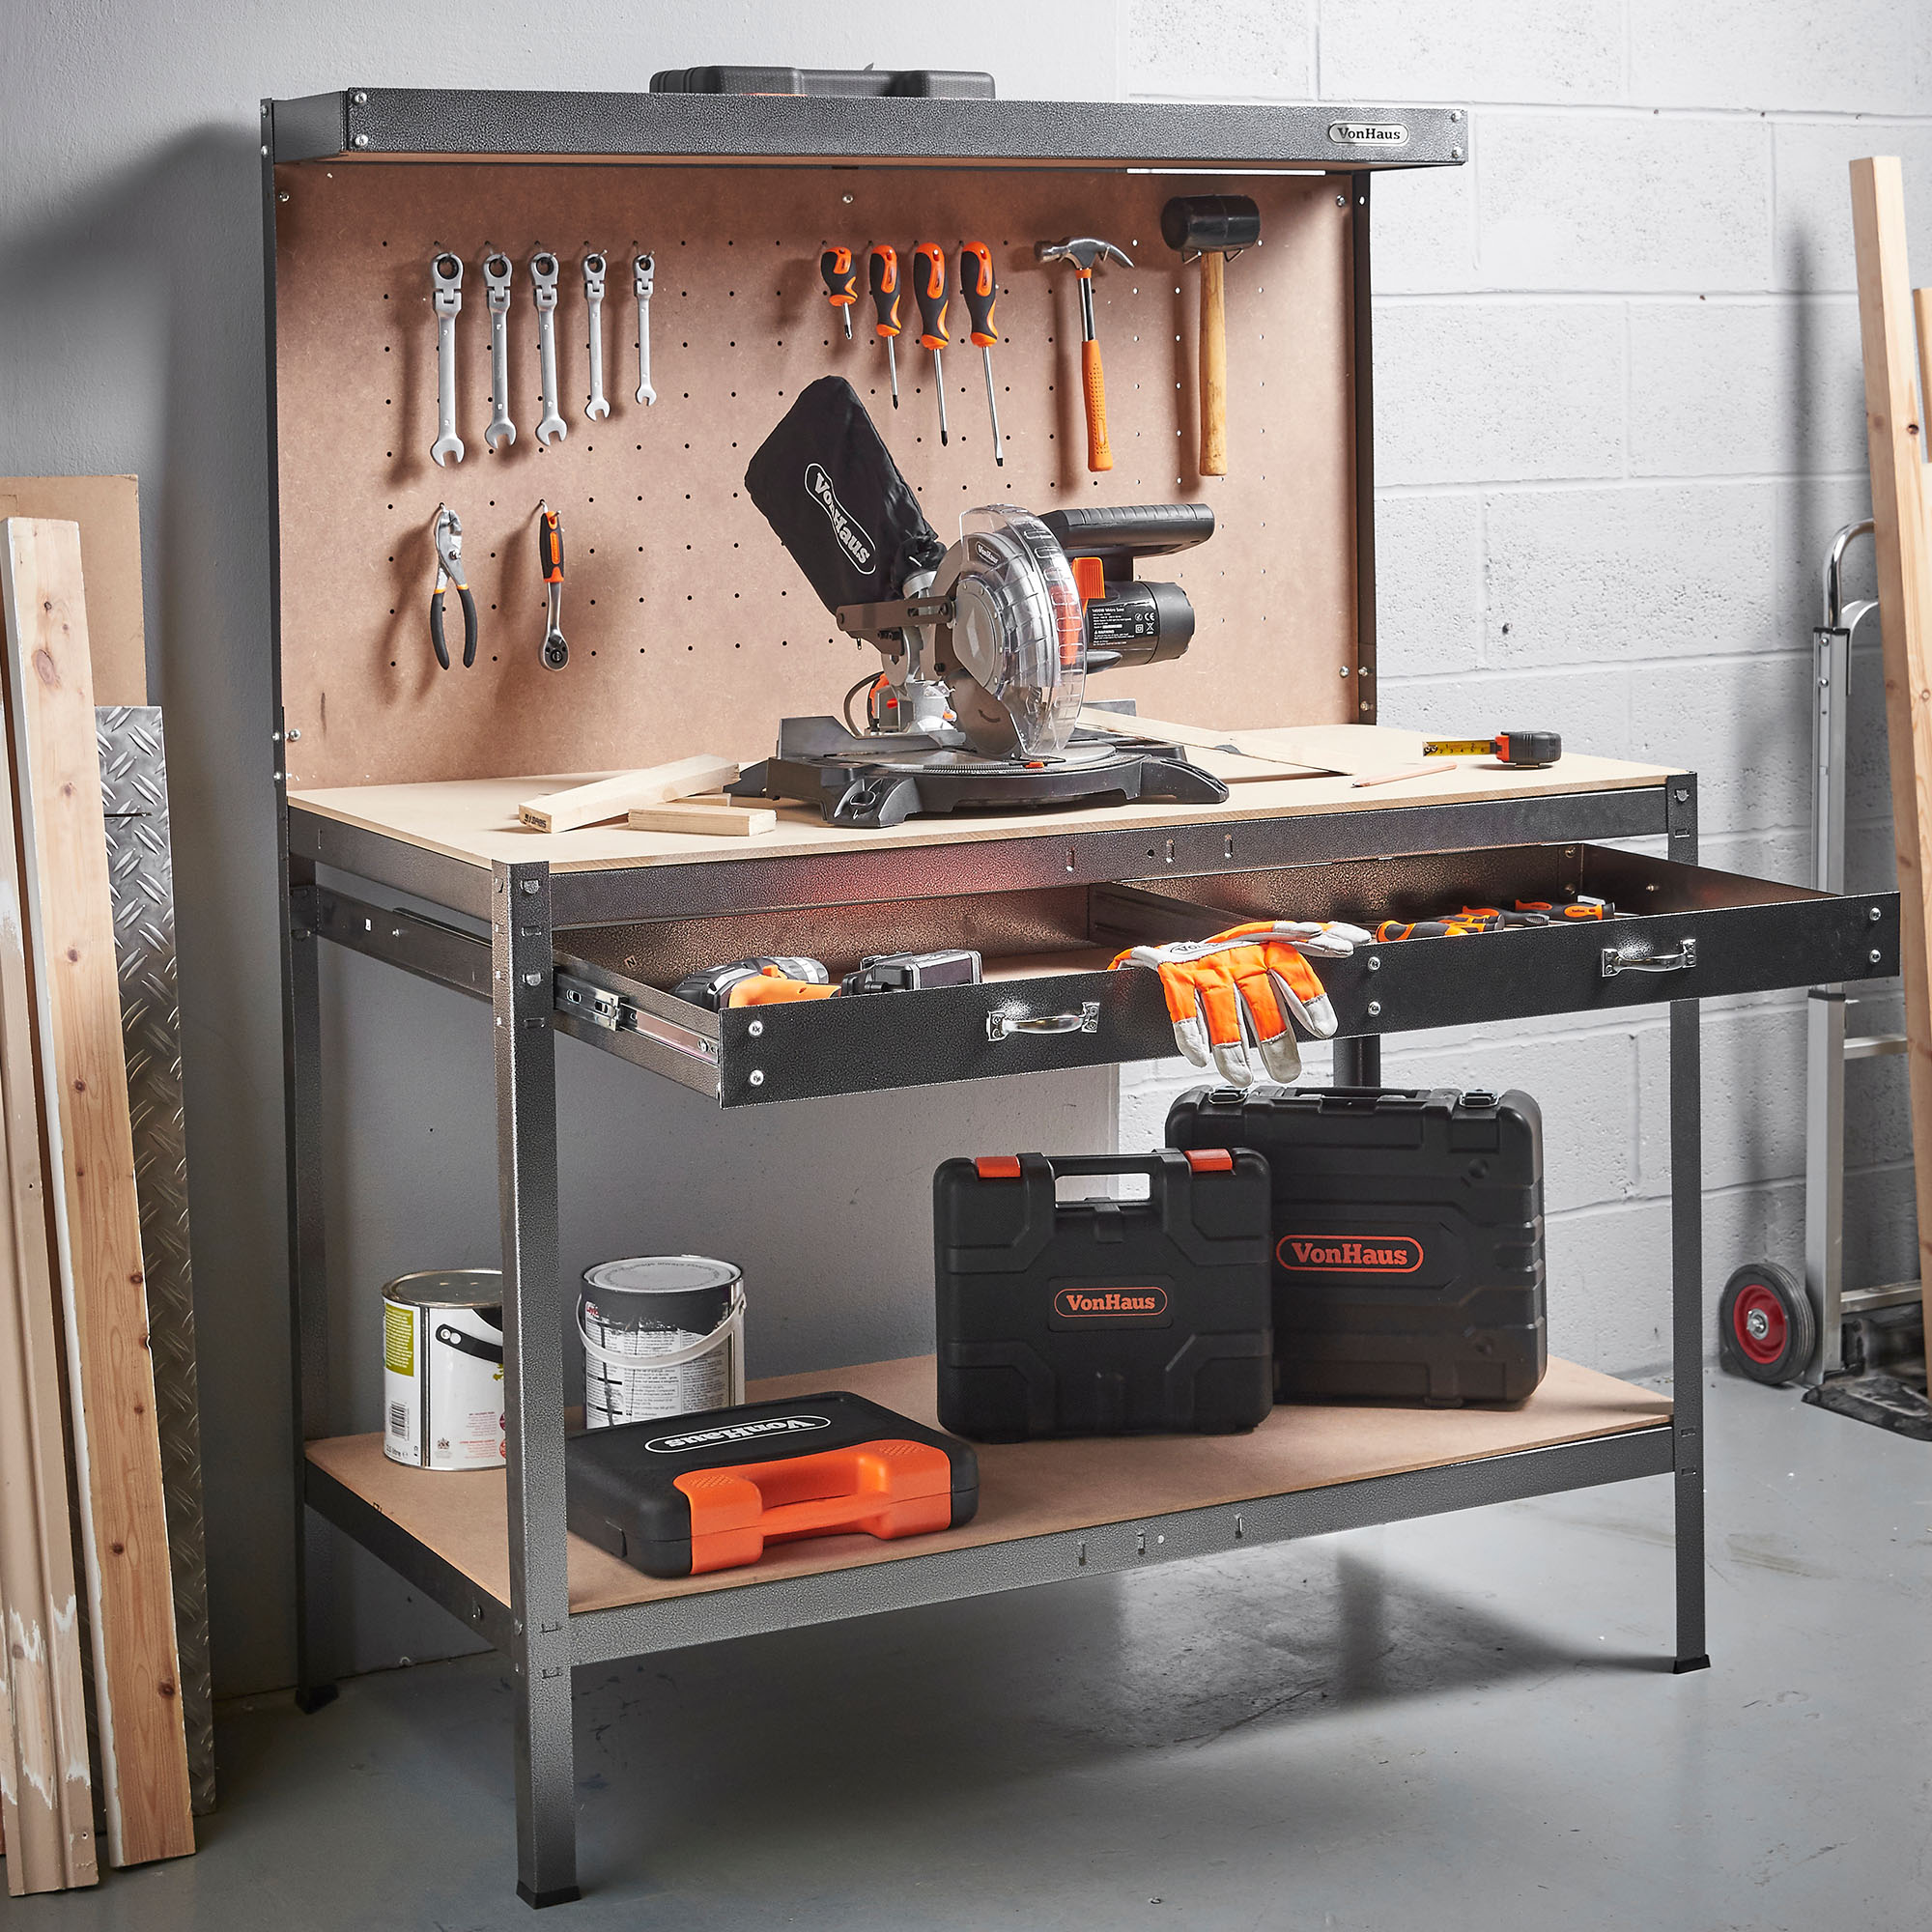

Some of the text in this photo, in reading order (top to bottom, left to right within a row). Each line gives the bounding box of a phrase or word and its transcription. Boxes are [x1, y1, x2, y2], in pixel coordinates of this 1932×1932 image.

[1337, 128, 1401, 140] VonHaus
[813, 472, 870, 564] VonHaus
[1292, 1242, 1407, 1265] VonHaus
[1066, 1293, 1155, 1311] VonHaus
[664, 1419, 815, 1448] VonHaus
